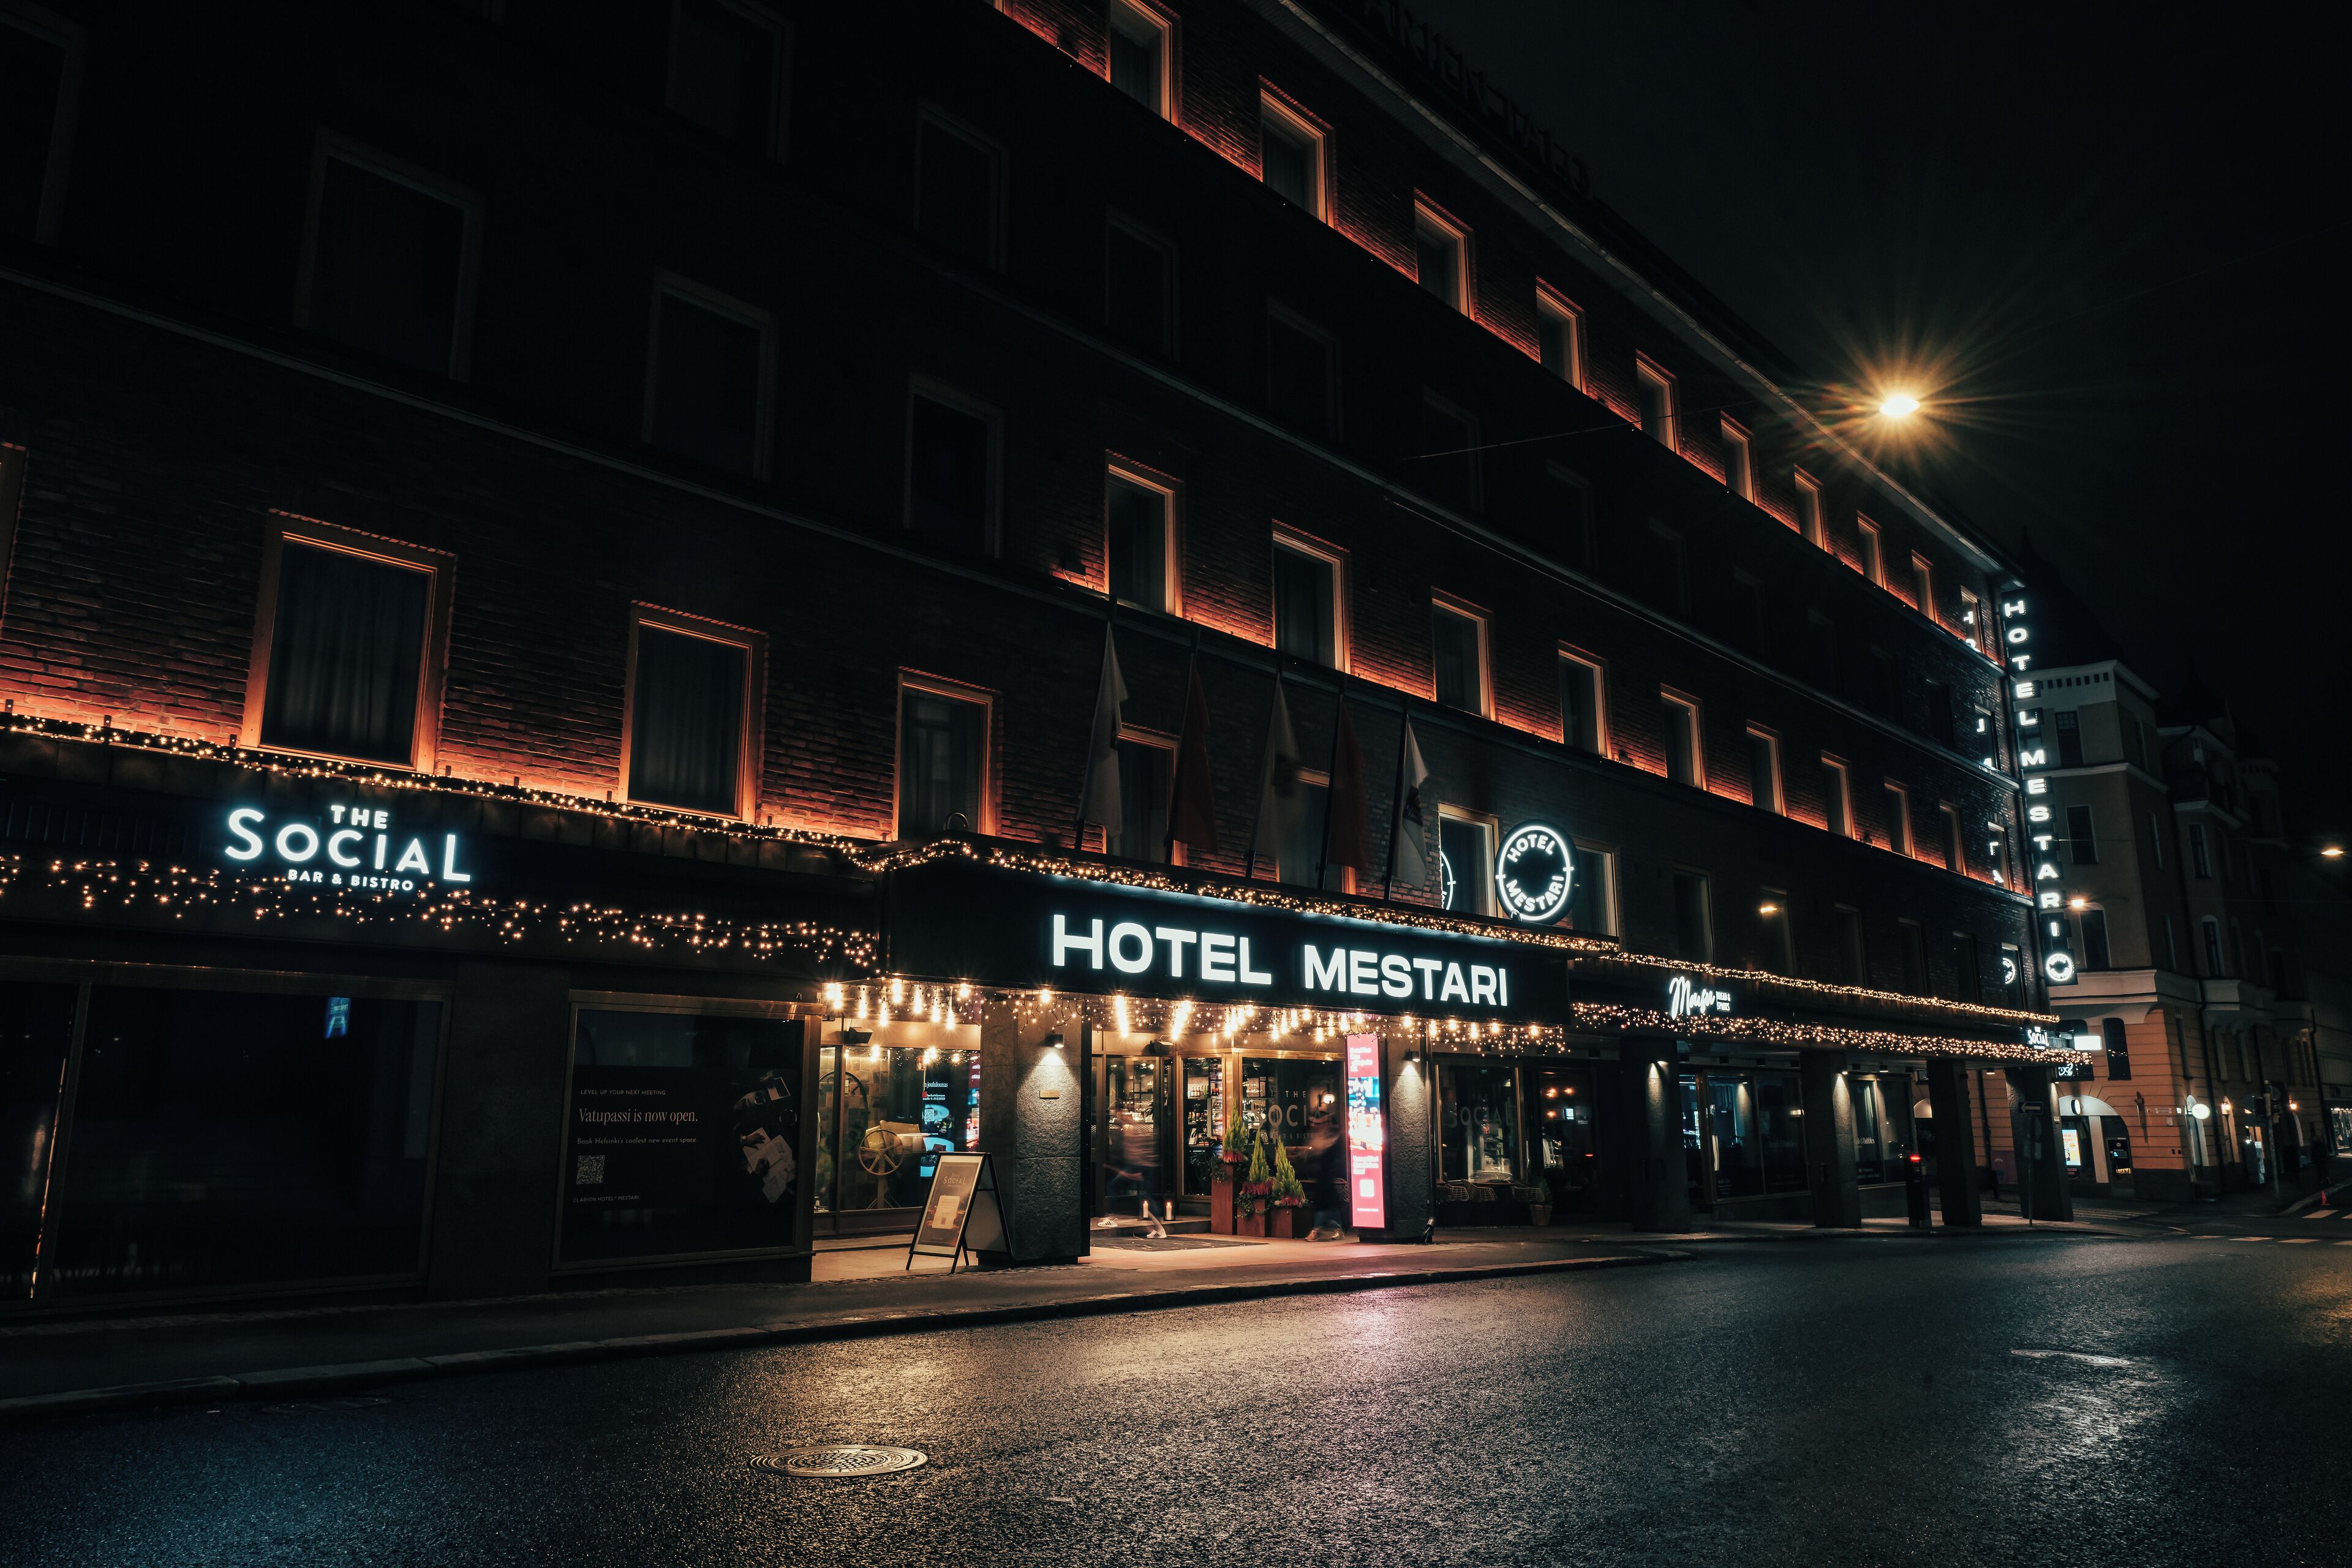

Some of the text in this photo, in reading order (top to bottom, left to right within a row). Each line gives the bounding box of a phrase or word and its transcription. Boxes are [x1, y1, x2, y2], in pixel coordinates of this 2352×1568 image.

[2004, 600, 2038, 727] HOTEL
[2021, 748, 2062, 937] MESTARI
[330, 805, 388, 829] THE
[224, 807, 471, 882] SOCIAL
[1506, 834, 1556, 862] HOTEL
[288, 869, 414, 891] BAR & BISTRO
[1505, 875, 1565, 912] MESTARI
[1051, 914, 1509, 1007] HOTEL MESTARI
[2028, 1029, 2049, 1046] SOCIAL
[579, 1108, 698, 1125] Vatupassi is now open.
[943, 1176, 967, 1185] SOCIAL
